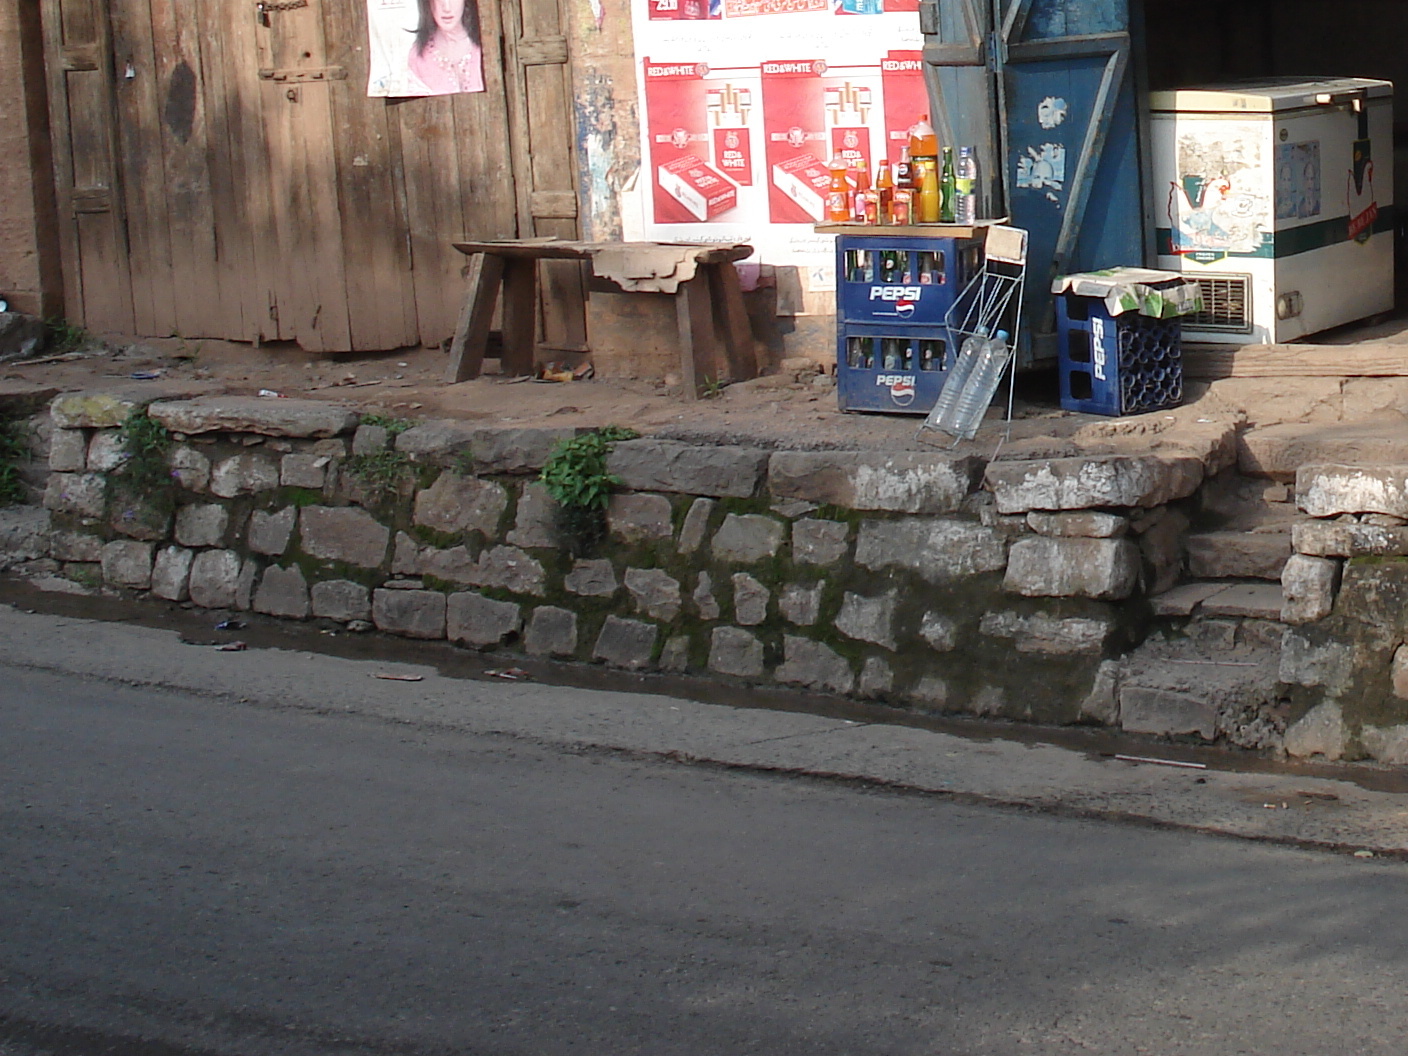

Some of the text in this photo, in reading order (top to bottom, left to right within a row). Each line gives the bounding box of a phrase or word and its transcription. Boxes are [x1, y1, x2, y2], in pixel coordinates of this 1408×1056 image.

[870, 286, 921, 301] PEPSI
[1092, 316, 1106, 381] PEPSI
[876, 374, 916, 386] PEPSI
